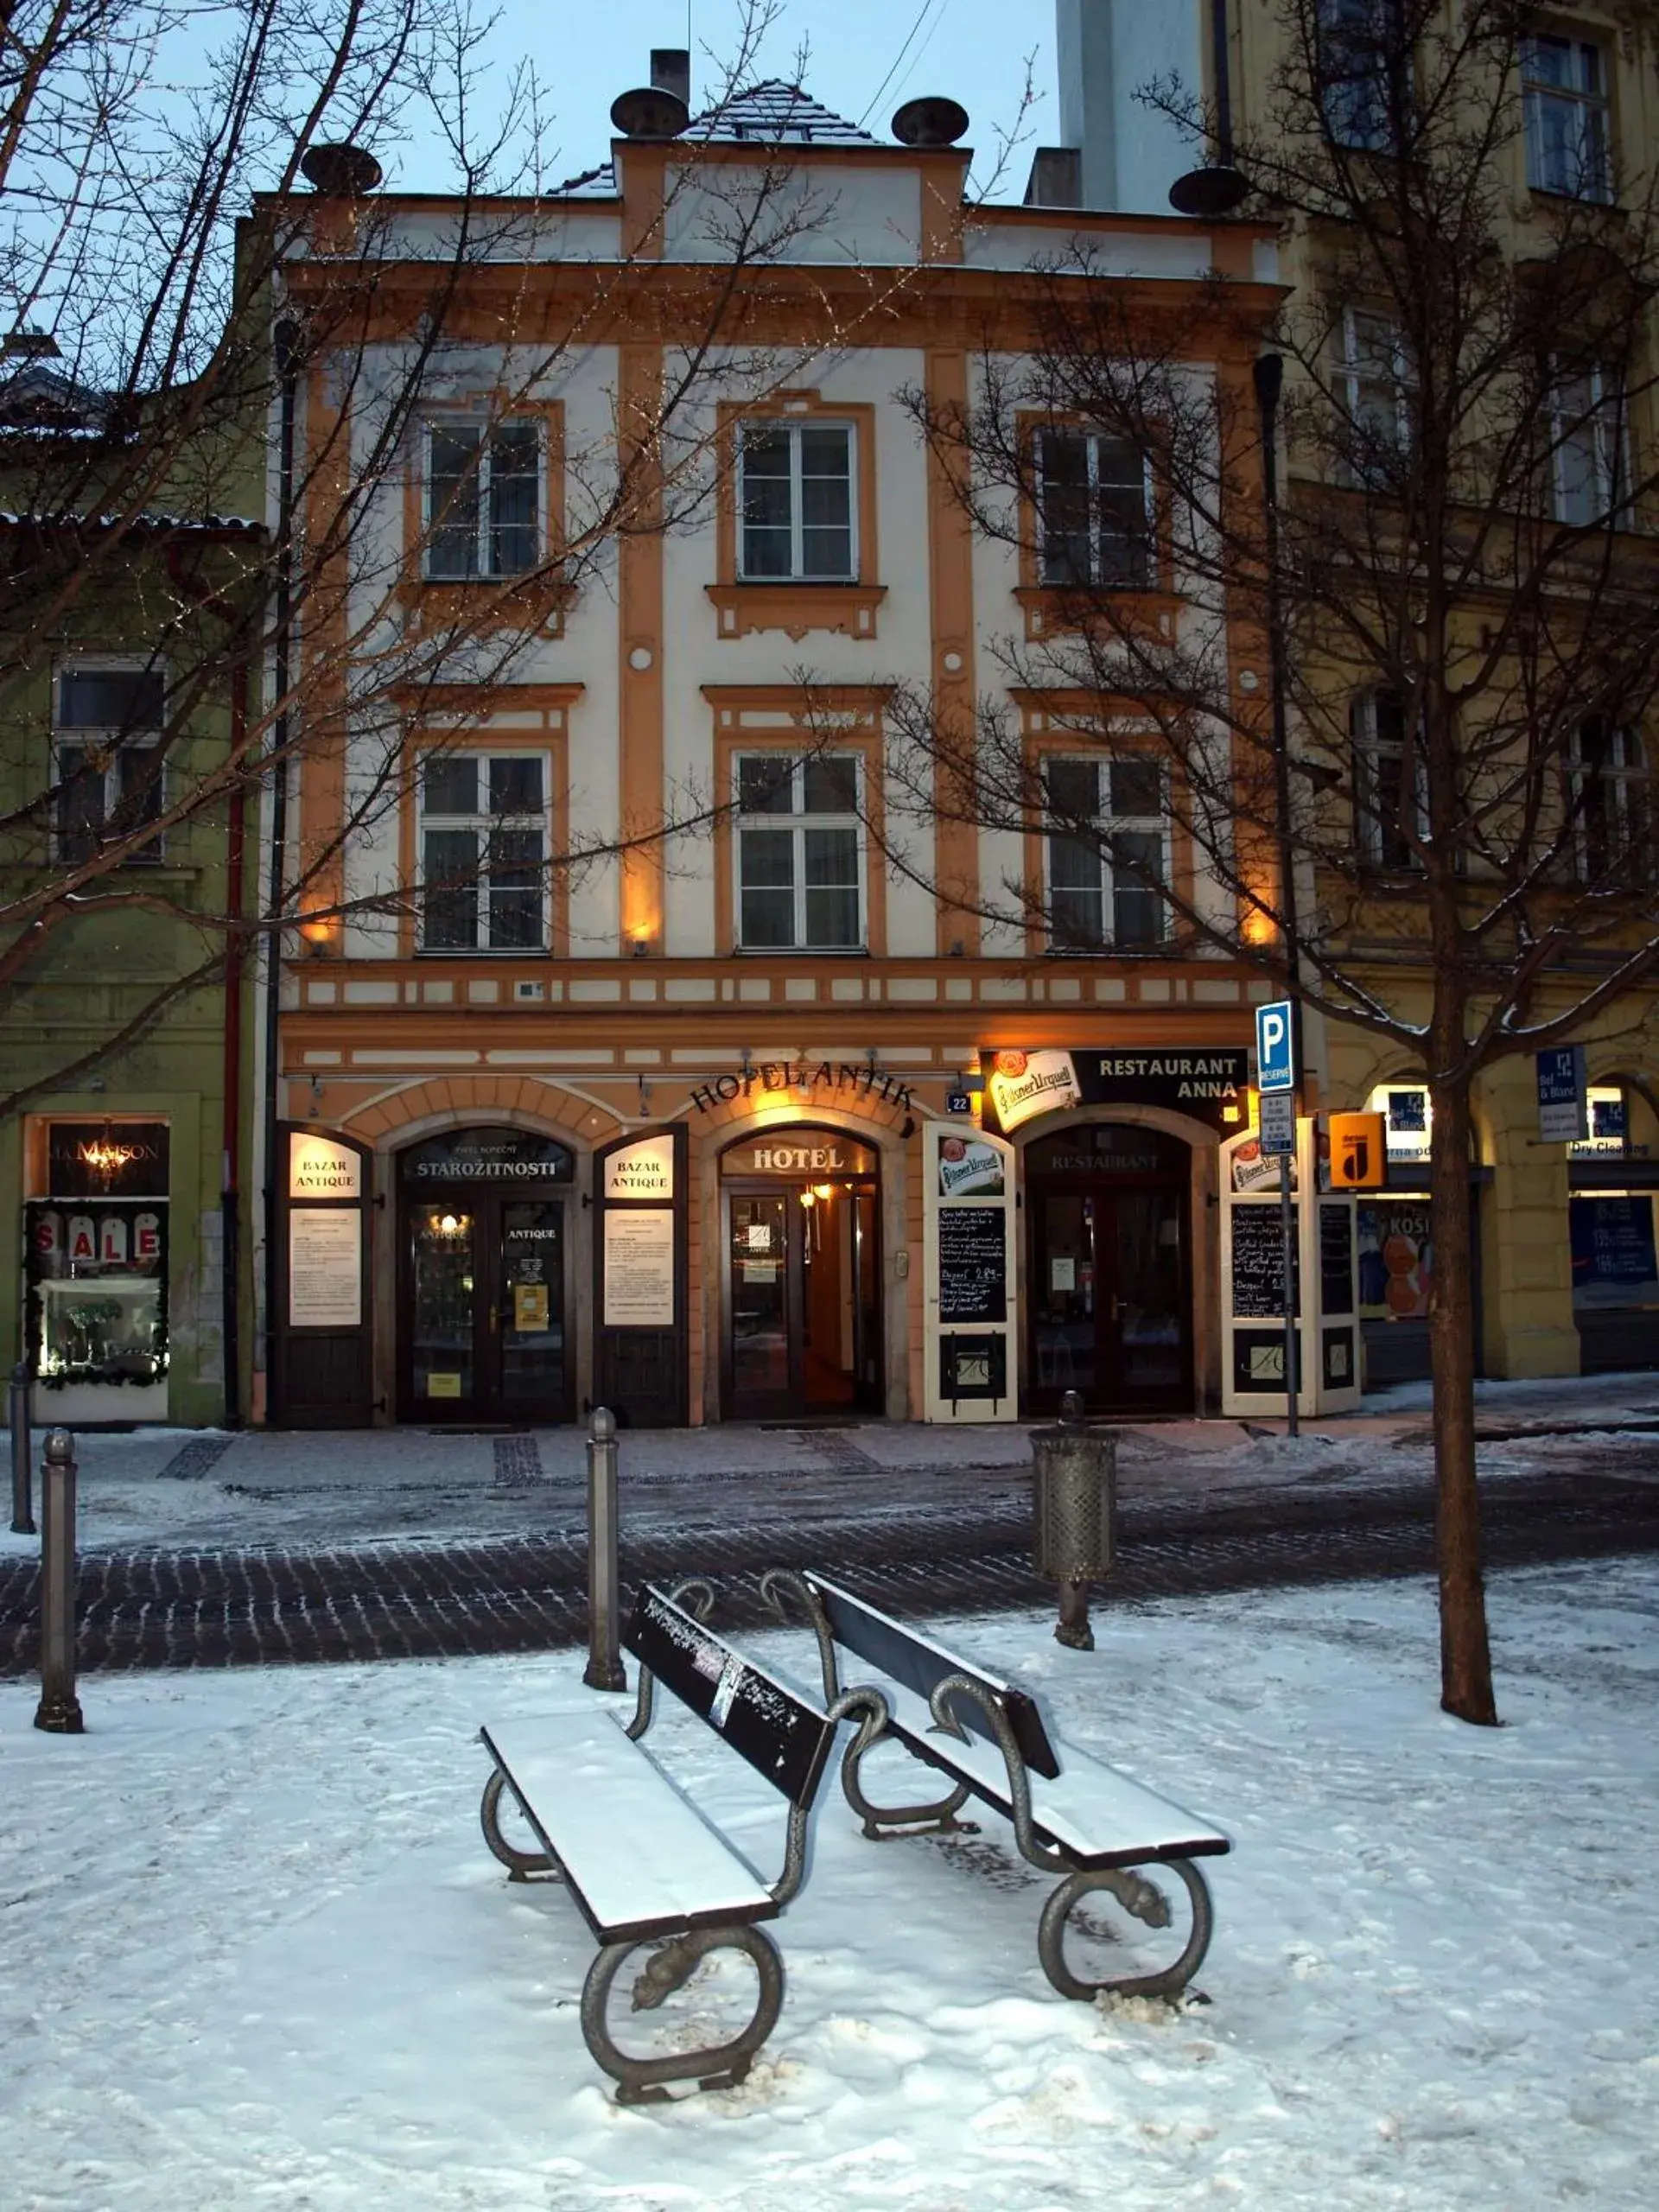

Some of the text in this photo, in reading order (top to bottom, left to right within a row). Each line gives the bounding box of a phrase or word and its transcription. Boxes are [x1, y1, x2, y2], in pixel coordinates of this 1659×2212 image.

[1263, 1014, 1284, 1065] P
[1100, 1059, 1236, 1076] RESTAURANT
[813, 1061, 917, 1112] ANTIK
[1033, 1065, 1072, 1092] Urquell
[1178, 1082, 1237, 1098] ANNA
[953, 1097, 968, 1110] 22
[302, 1160, 346, 1171] BAZAR
[617, 1162, 660, 1172] BAZAR
[753, 1149, 843, 1169] HOTEL
[1052, 1155, 1158, 1169] RESTAURANT
[416, 1159, 556, 1178] STAROŽITNOSTI
[295, 1176, 354, 1188] ANTIQUE
[610, 1178, 668, 1189] ANTIQUE
[508, 1229, 556, 1239] ANTIQUE
[36, 1224, 157, 1261] SALE
